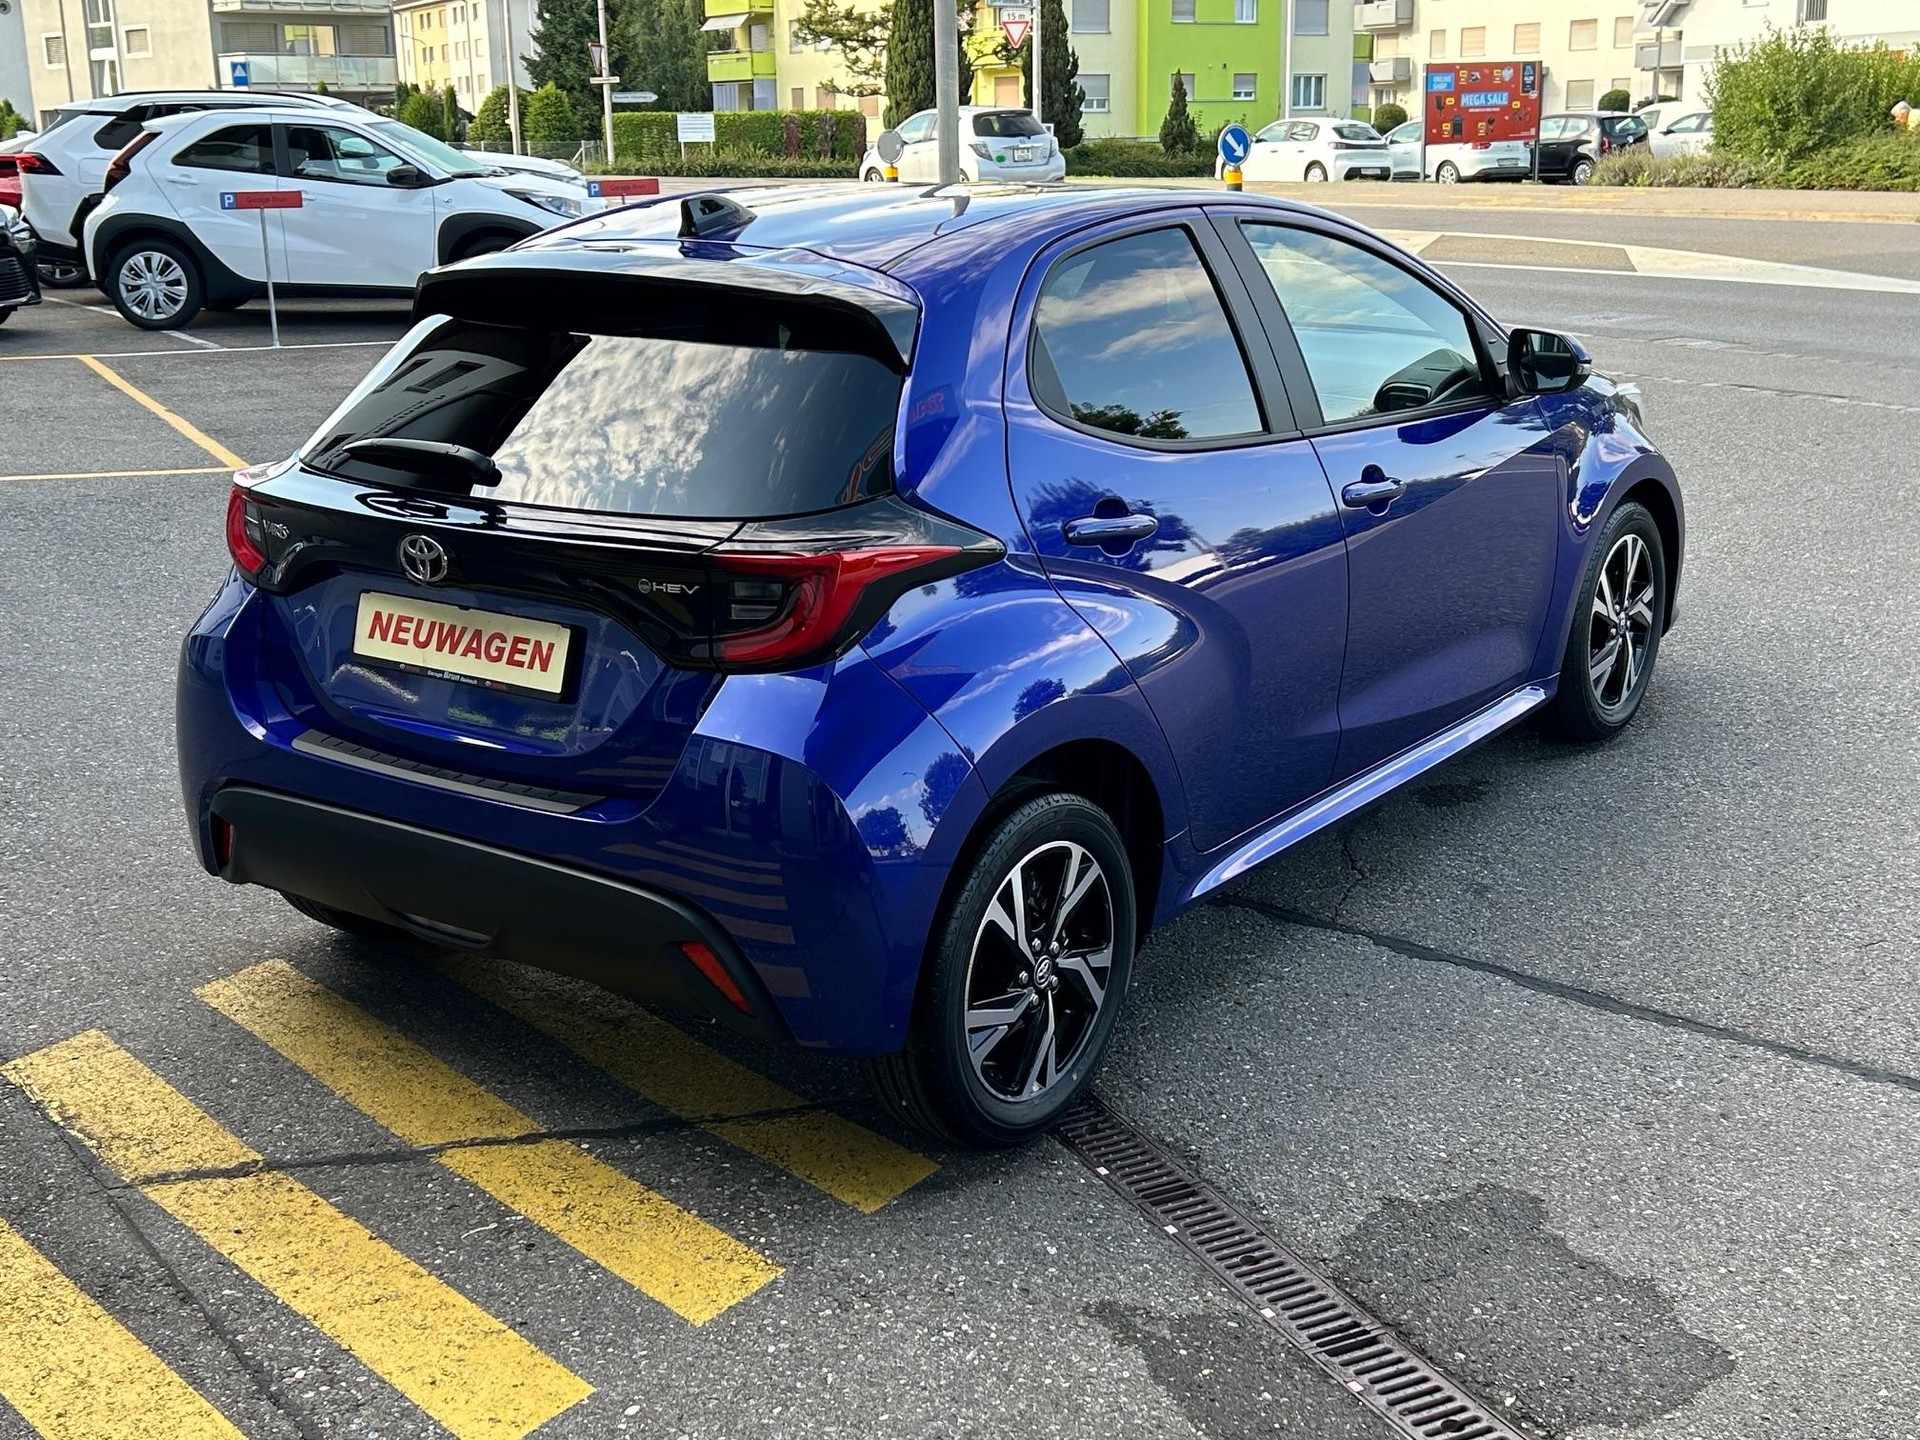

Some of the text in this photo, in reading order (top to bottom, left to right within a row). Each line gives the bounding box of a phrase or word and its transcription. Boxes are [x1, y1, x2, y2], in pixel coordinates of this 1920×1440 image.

[1433, 75, 1452, 83] ONLINE
[1433, 82, 1448, 90] SHOP
[1461, 93, 1486, 107] MEGA
[1487, 92, 1508, 105] SALE
[590, 183, 599, 195] P
[224, 194, 234, 207] P
[652, 582, 700, 595] HEV
[367, 610, 555, 673] NEUWAGEN
[427, 669, 443, 678] Garage
[443, 671, 460, 682] Brun
